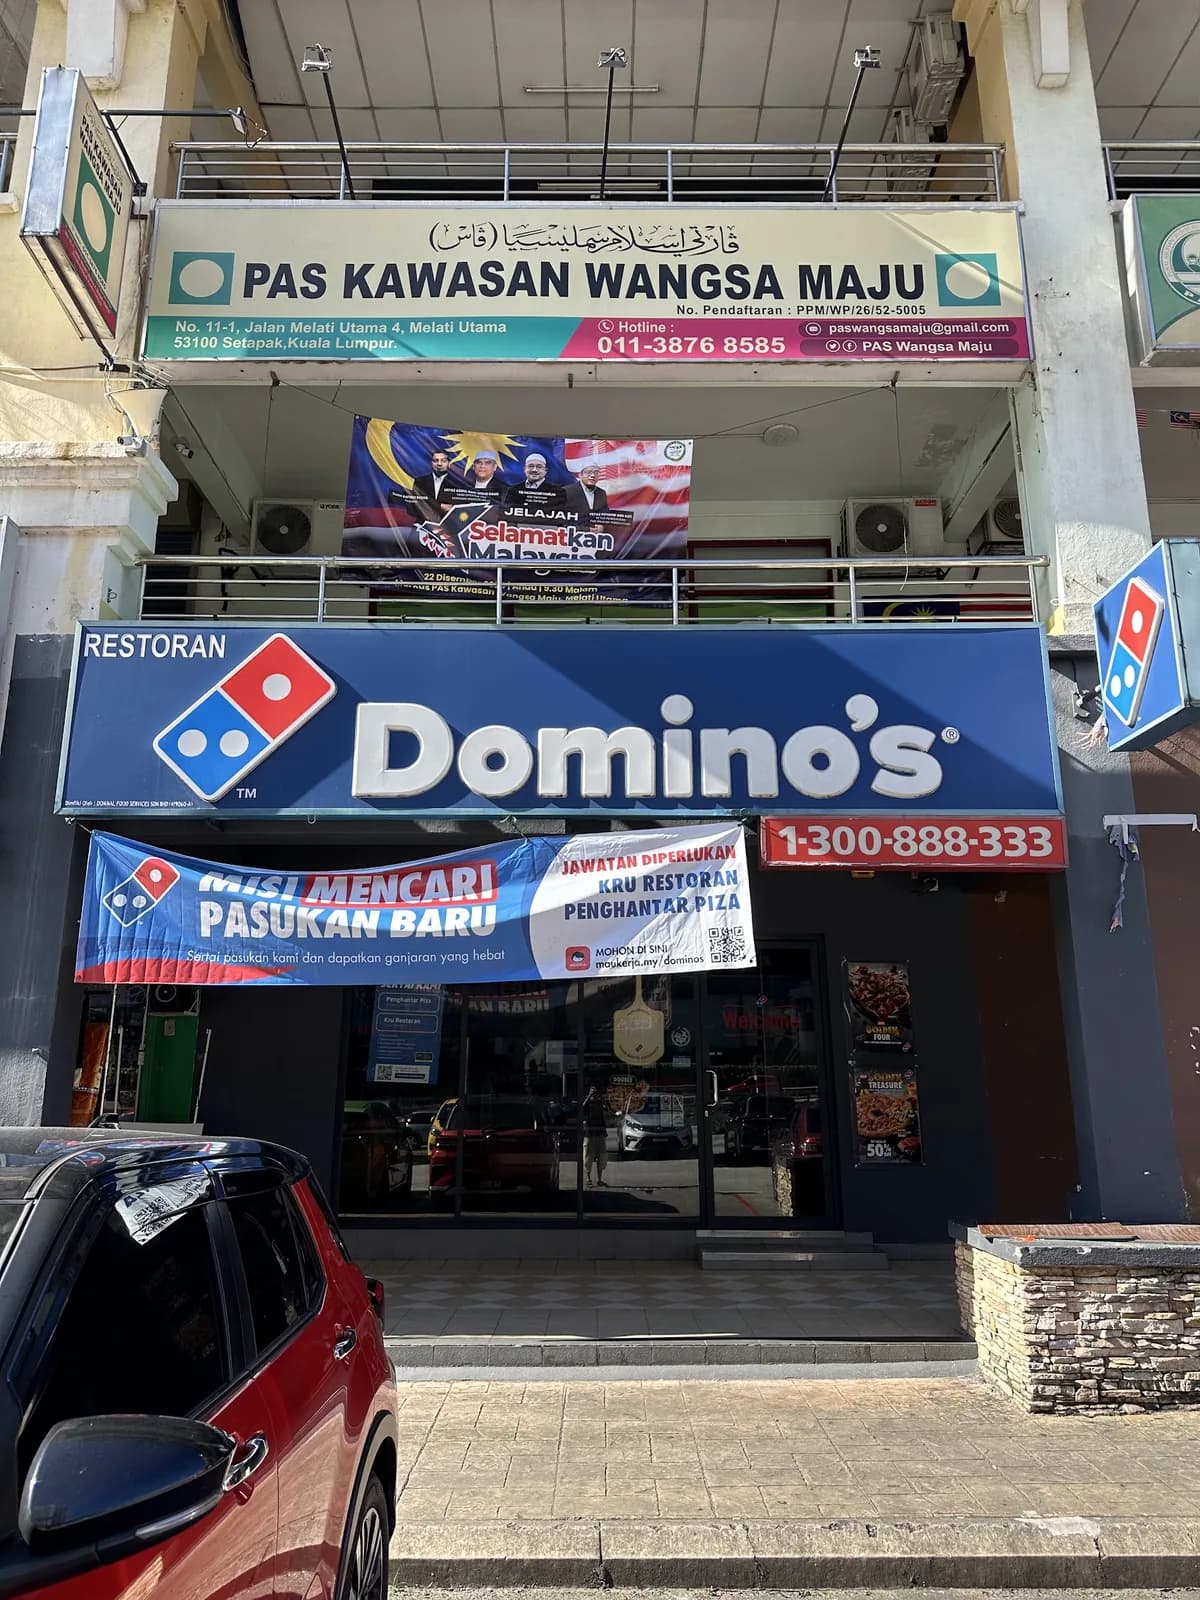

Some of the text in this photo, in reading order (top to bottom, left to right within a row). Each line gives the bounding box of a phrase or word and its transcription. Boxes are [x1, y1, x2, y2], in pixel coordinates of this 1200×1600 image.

[82, 115, 94, 142] PAS
[94, 141, 122, 202] KAWASAN
[243, 261, 924, 300] PAS KAWASAN WANGSA MAJU
[676, 305, 698, 315] No.
[704, 305, 782, 315] Pendaftaran
[797, 305, 926, 315] PPM/WP/26/52-5005
[176, 321, 507, 335] No. 11-1, Jalan Melati Utama 4, Melati Utama
[619, 321, 666, 333] Hotline
[829, 322, 1009, 335] paswangsamaju@gmail.com
[174, 337, 217, 349] 53100
[336, 338, 398, 351] Lumpur.
[598, 337, 786, 353] 011-3876 8585
[863, 341, 993, 354] PAS Wangsa Maju
[504, 507, 578, 521] JELAJAH
[469, 521, 614, 550] Selamatkan
[451, 585, 495, 595] Kawasan
[84, 633, 226, 658] RESTORAN
[236, 788, 257, 799] TM
[778, 825, 1053, 857] 1-300-888-333
[561, 845, 737, 876] JAWATAN DIPERLUKAN
[198, 863, 493, 905] MISI MENCARI
[599, 870, 738, 894] KRU RESTORAN
[564, 893, 741, 920] PENGHANTAR PIZA
[200, 901, 497, 938] PASUKAN BARU
[186, 948, 505, 966] Sertai pasukan kami dan dapatkan ganjaran yang hebat
[596, 945, 668, 956] MOHON DI SINI
[596, 954, 704, 970] maukerja.my/dominos
[869, 1081, 903, 1089] TREASURE
